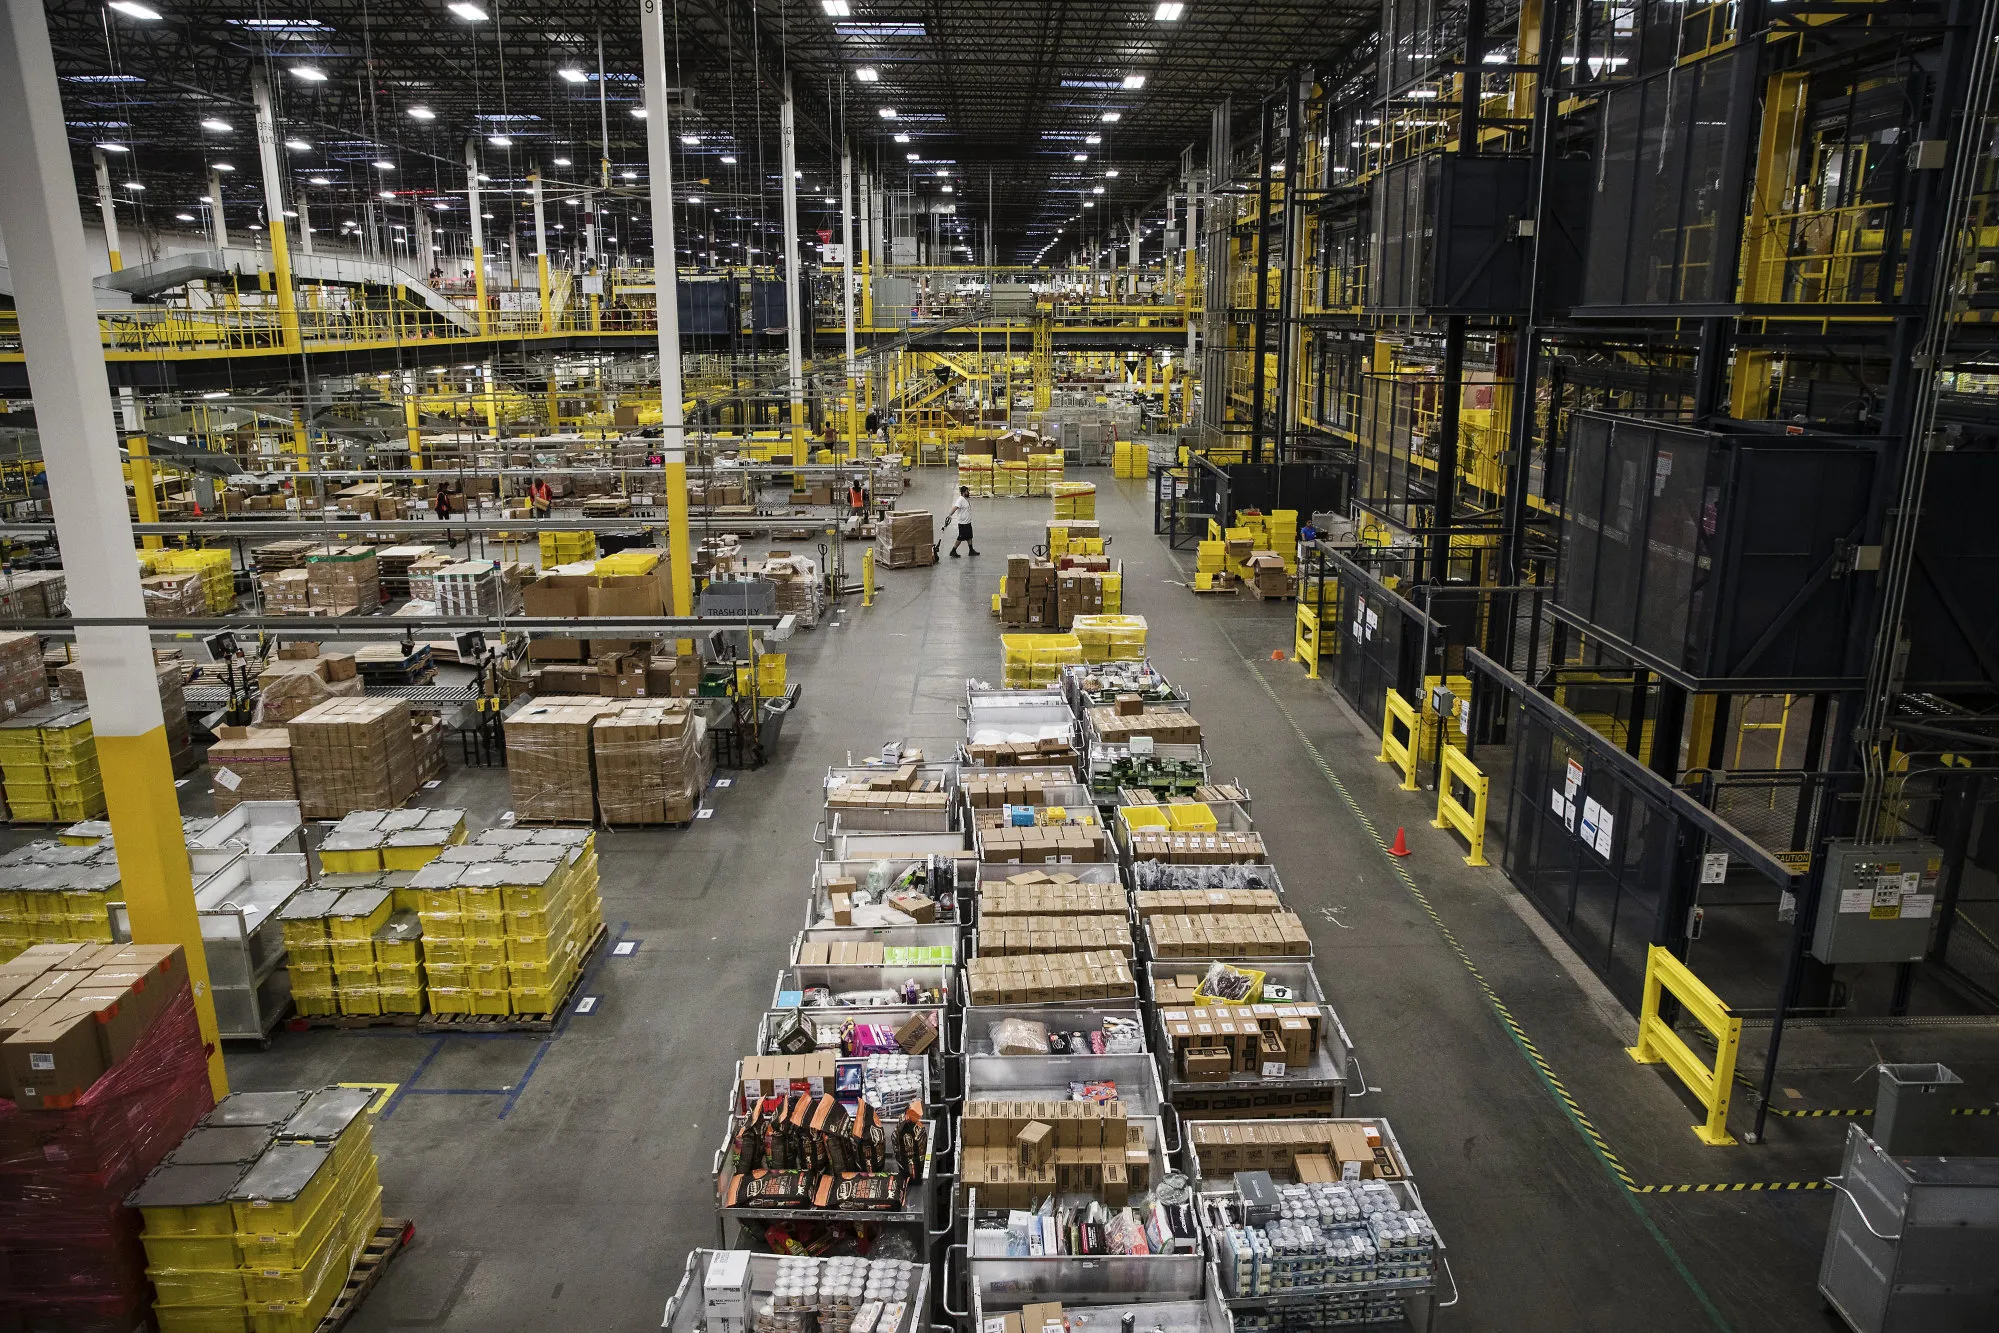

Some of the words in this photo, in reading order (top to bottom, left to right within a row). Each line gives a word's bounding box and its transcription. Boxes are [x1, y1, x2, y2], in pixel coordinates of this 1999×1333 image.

[645, 0, 654, 14] 9
[708, 608, 735, 616] TRASH
[737, 608, 760, 616] ONLY
[1775, 854, 1809, 863] CAUTION
